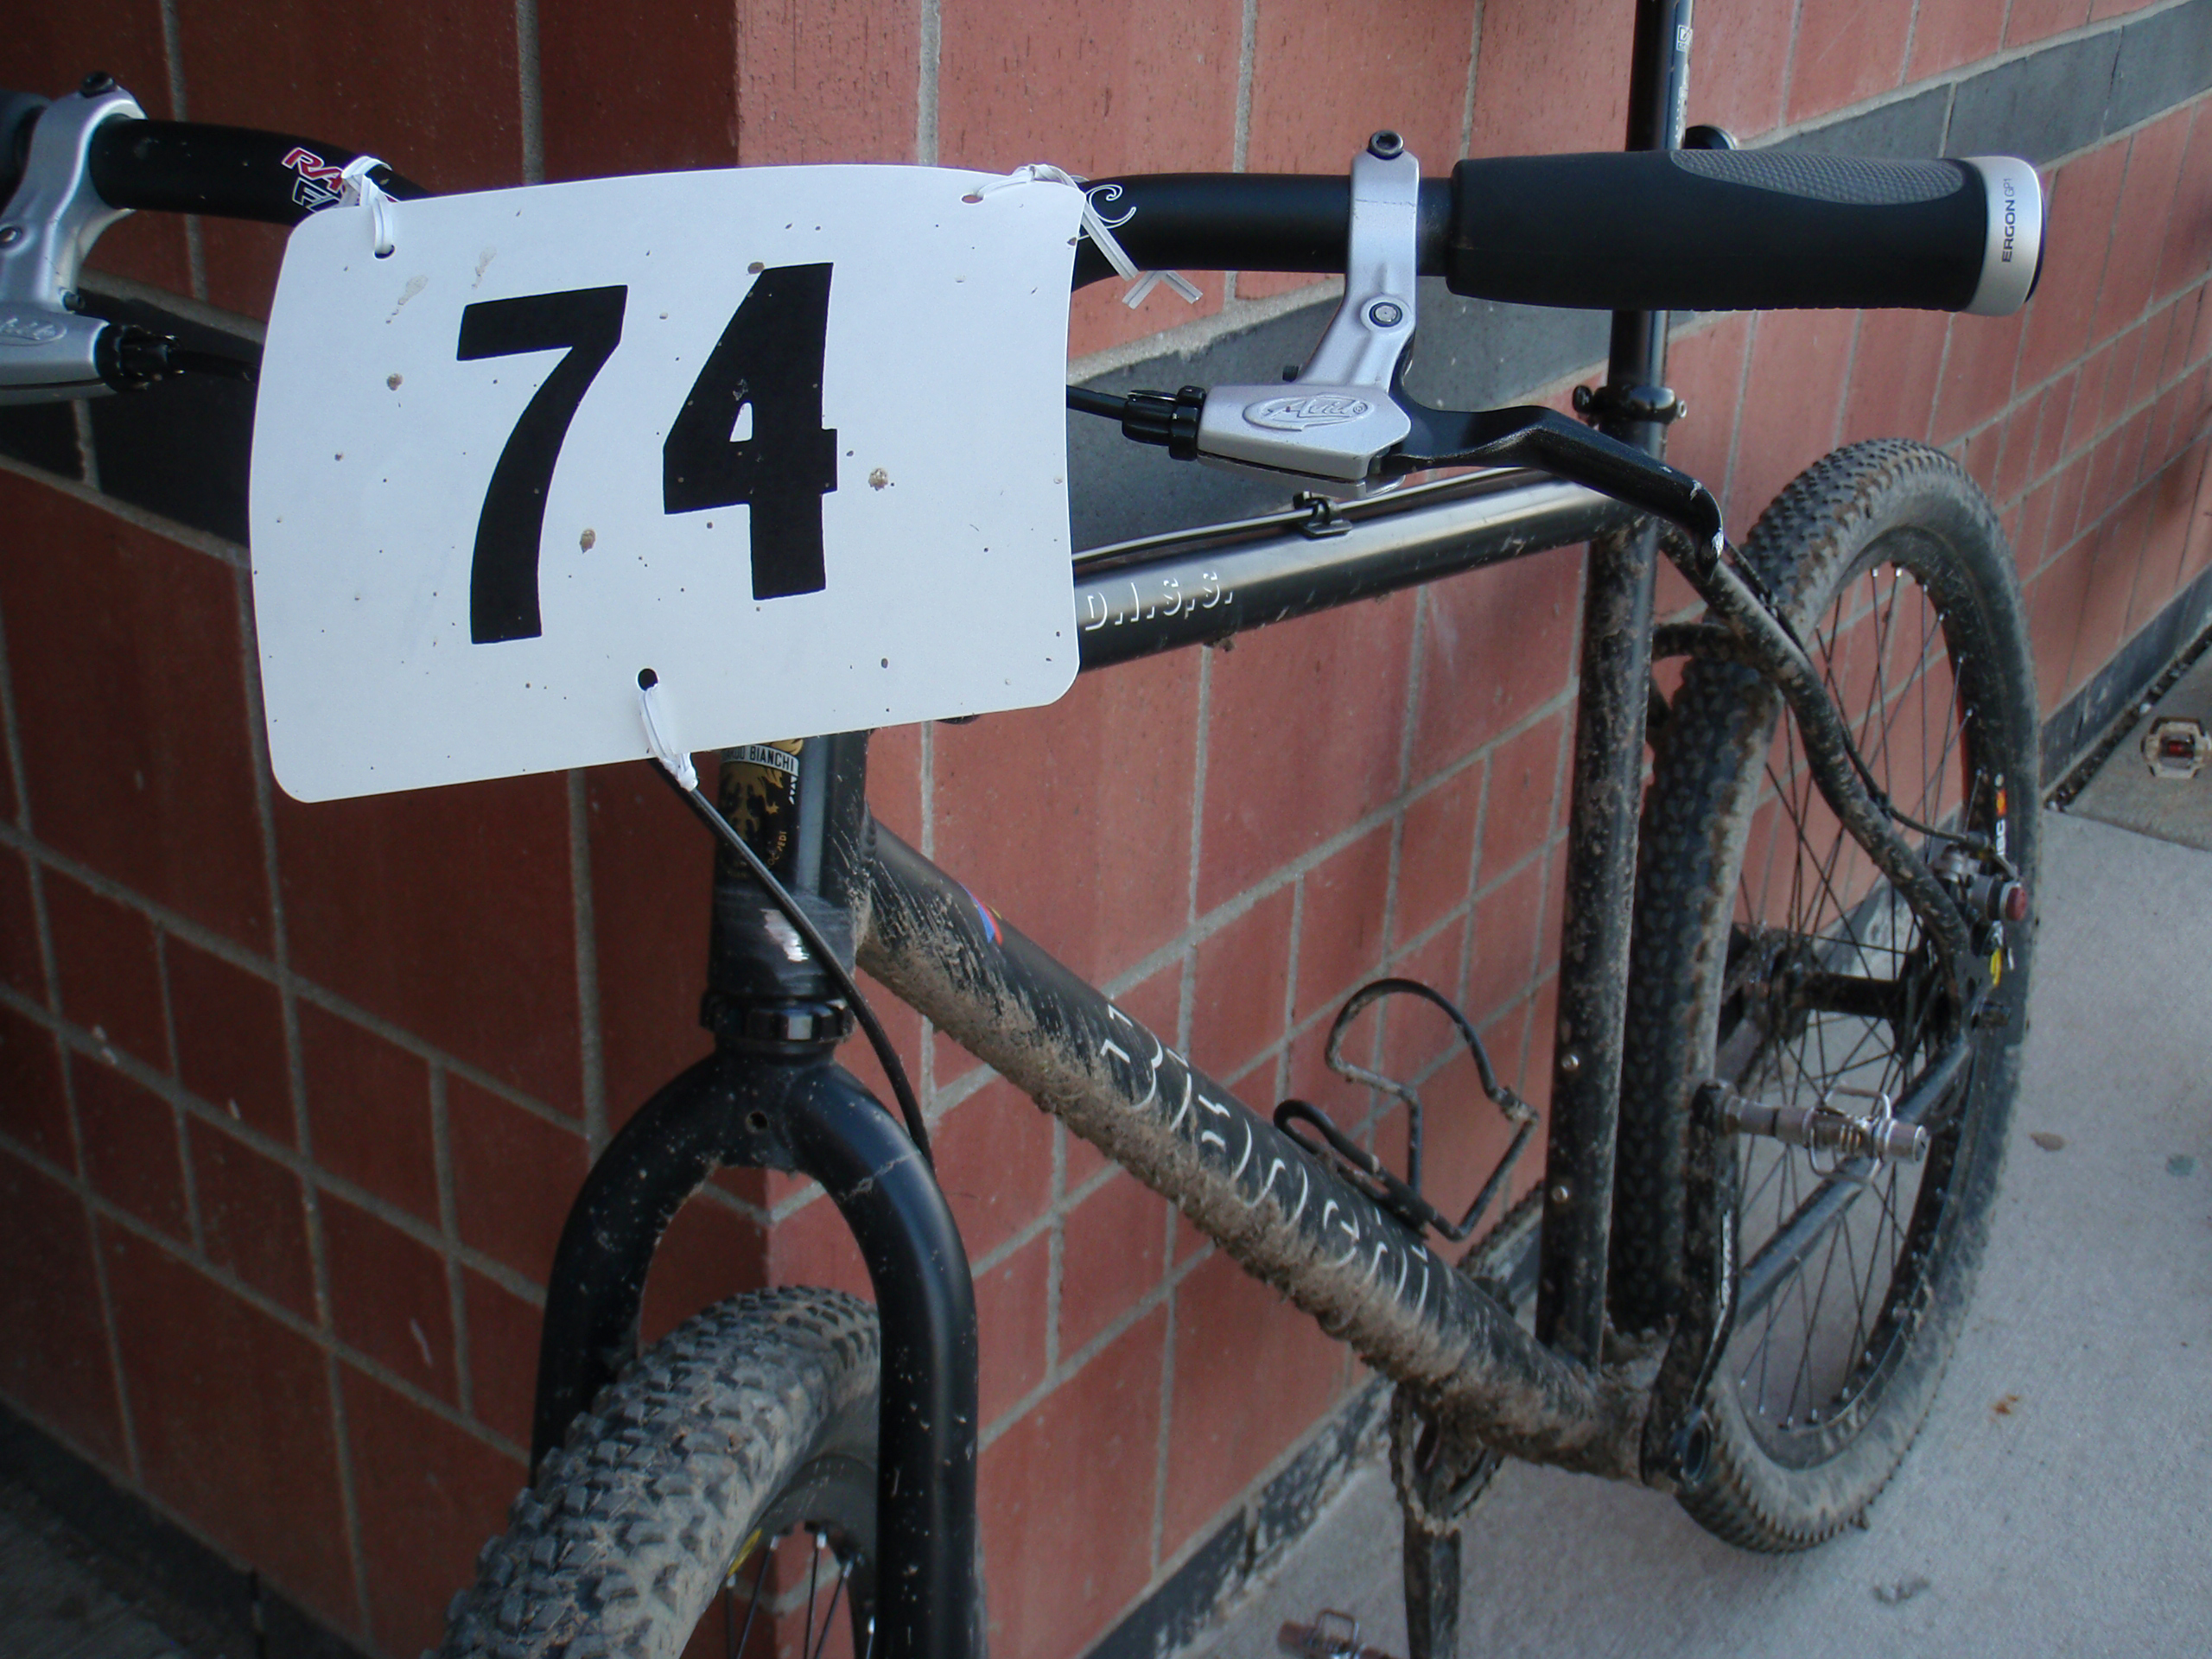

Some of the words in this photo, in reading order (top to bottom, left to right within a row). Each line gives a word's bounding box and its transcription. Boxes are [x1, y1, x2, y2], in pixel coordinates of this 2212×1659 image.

[2001, 200, 2016, 263] ERGON
[457, 262, 838, 644] 74
[749, 746, 794, 772] BIANCHI
